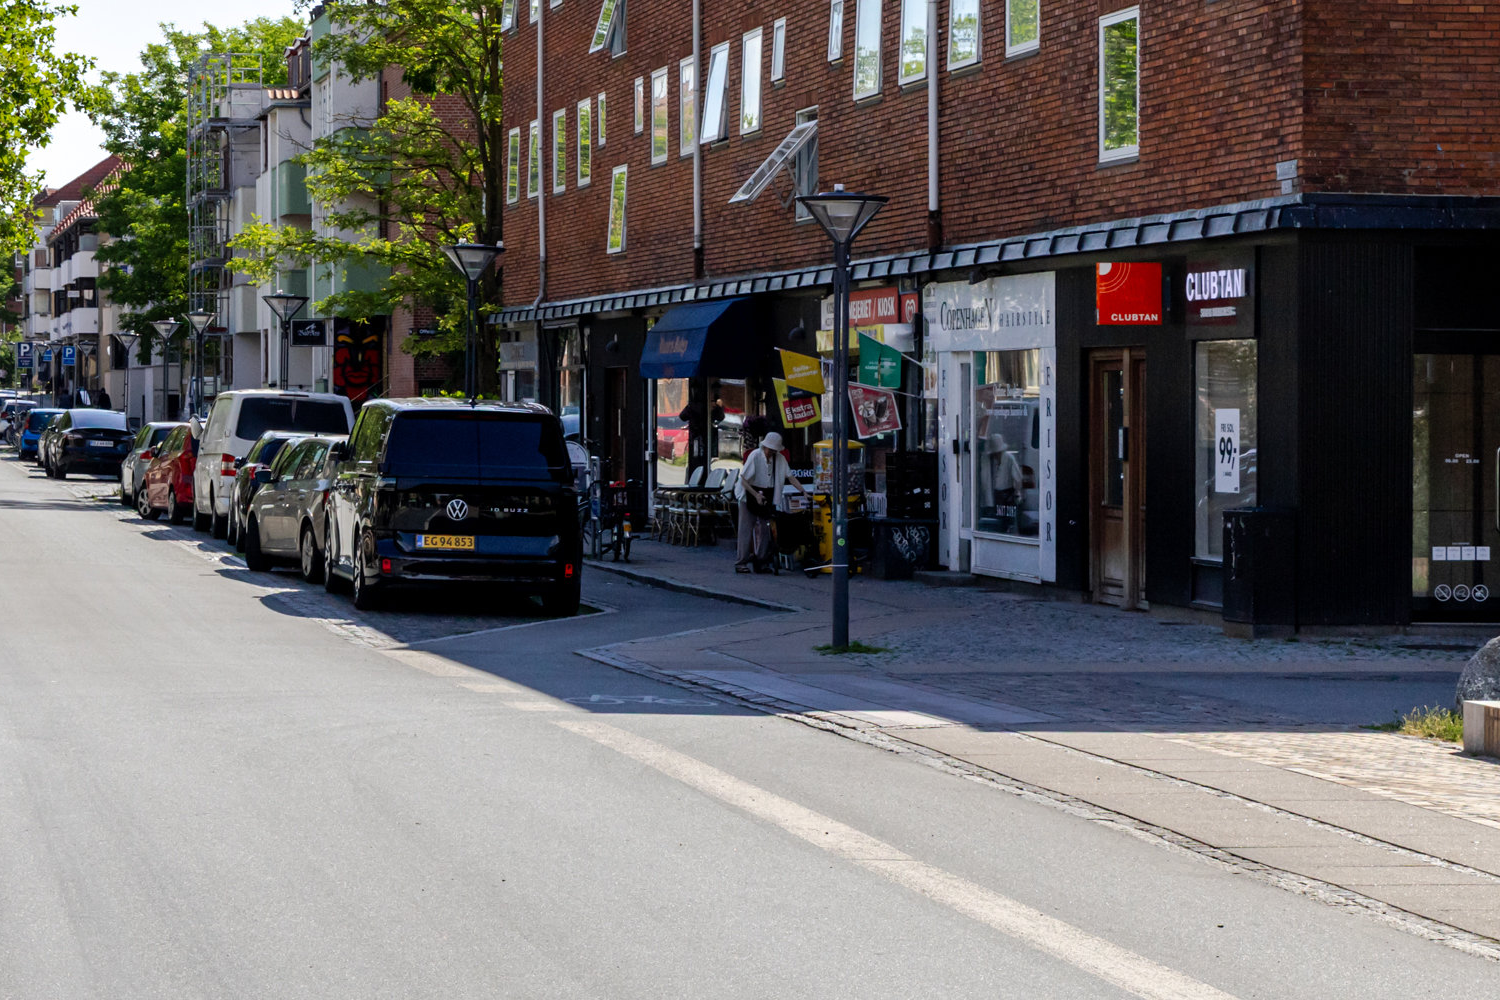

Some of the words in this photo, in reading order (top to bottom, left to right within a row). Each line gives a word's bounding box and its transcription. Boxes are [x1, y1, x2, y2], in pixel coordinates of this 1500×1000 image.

[1186, 269, 1244, 301] CLUBTAN
[877, 296, 895, 317] KIOSK
[999, 310, 1051, 327] HAIRSTYLE
[1111, 313, 1159, 322] CLUBTAN
[20, 343, 30, 357] P
[65, 347, 73, 358] P
[785, 403, 813, 415] Ekstra
[424, 536, 438, 546] EG
[440, 537, 452, 547] 94
[455, 537, 473, 547] 853
